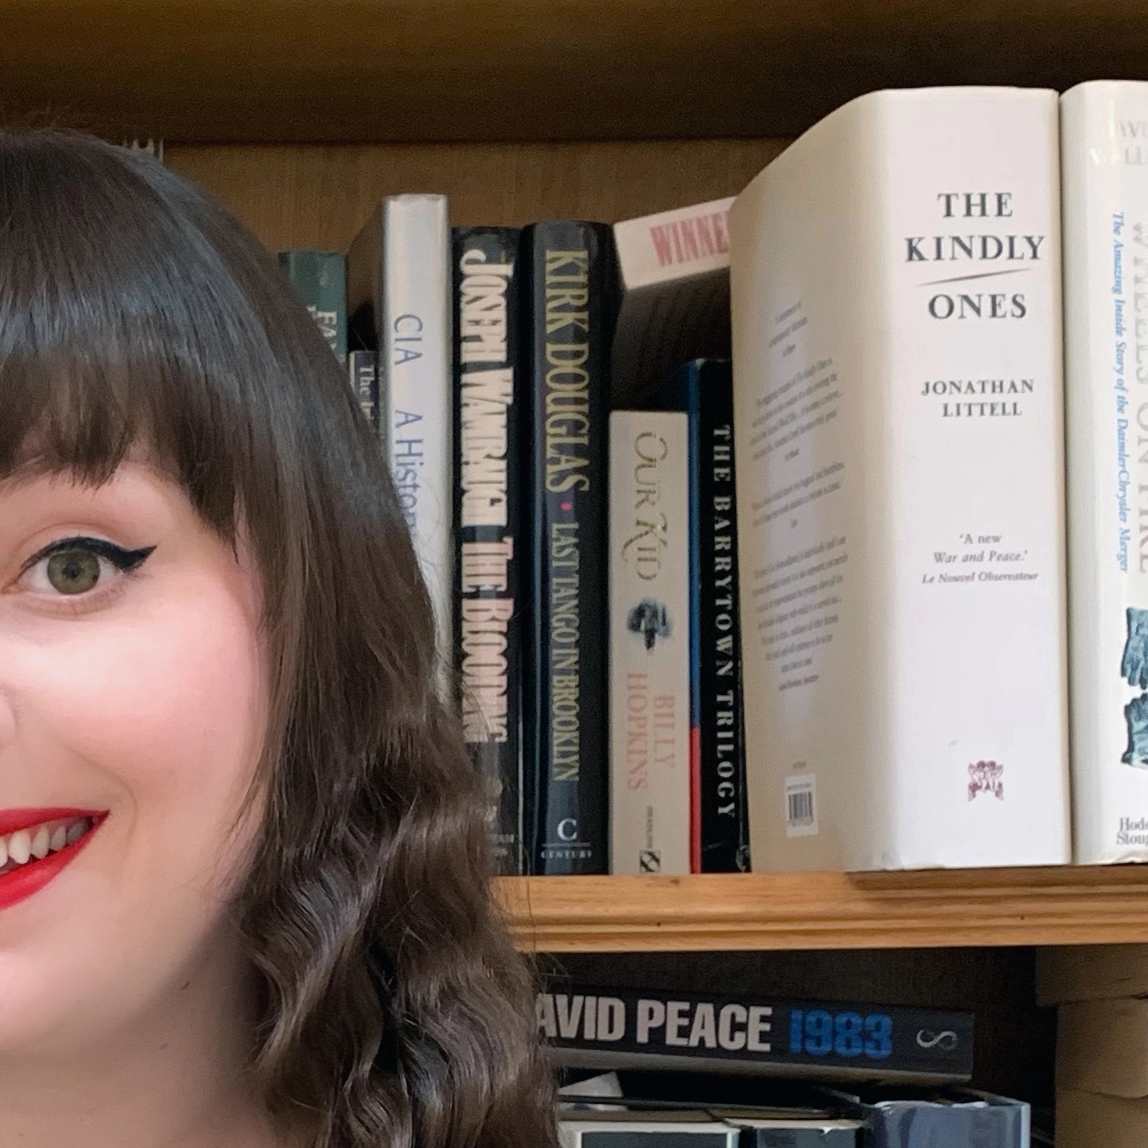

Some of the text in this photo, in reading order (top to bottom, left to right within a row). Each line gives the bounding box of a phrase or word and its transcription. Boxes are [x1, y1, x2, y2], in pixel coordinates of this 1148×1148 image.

[937, 192, 1013, 219] THE
[1112, 212, 1125, 235] The
[905, 235, 1046, 264] KINDLY
[1112, 239, 1124, 295] Amazing
[928, 294, 1027, 320] ONES
[393, 314, 424, 428] CIA A
[545, 250, 591, 491] KIRK DOUGLAS
[1113, 341, 1127, 375] Story
[359, 365, 375, 396] The
[921, 380, 1034, 396] JONATHAN
[1115, 377, 1129, 394] of
[942, 403, 1023, 418] LITTELL
[1116, 394, 1128, 414] the
[978, 534, 1001, 544] new
[461, 537, 514, 593] THE
[933, 551, 984, 564] War and
[922, 574, 935, 584] Le
[713, 424, 736, 818] THE BARRYTOWN TRILOGY
[552, 522, 580, 781] LAST TANGO IN BROOKLYN
[627, 672, 648, 791] HOPKINS
[653, 694, 676, 768] BILLY
[557, 818, 577, 841] C
[636, 1000, 894, 1060] PEACE 1983
